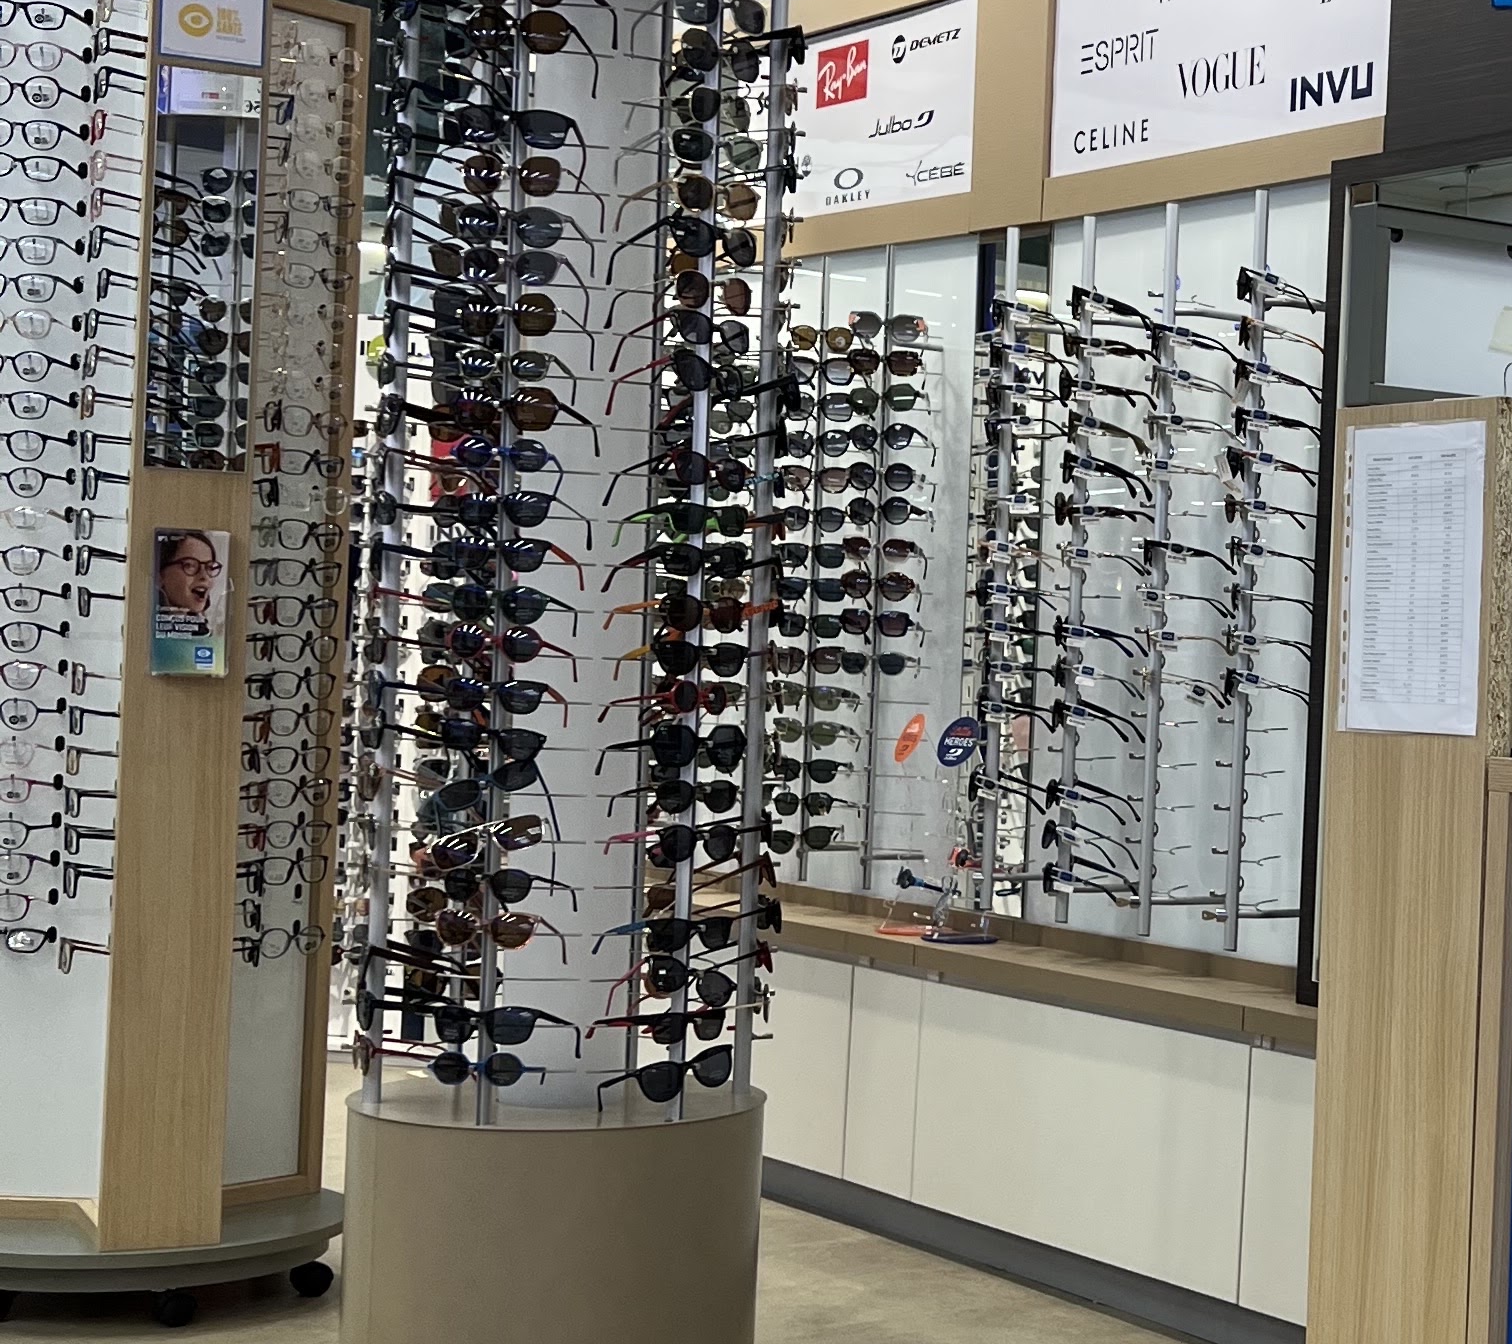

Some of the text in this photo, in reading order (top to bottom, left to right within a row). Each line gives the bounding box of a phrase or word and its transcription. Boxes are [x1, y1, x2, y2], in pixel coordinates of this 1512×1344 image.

[909, 28, 962, 52] DEMETZ
[1080, 28, 1159, 75] ESPRIT
[1177, 44, 1267, 99] VOGUE
[1289, 61, 1374, 113] INVU
[868, 115, 912, 139] Julbo
[1073, 118, 1150, 155] CELINE
[825, 190, 870, 206] OAKLEY
